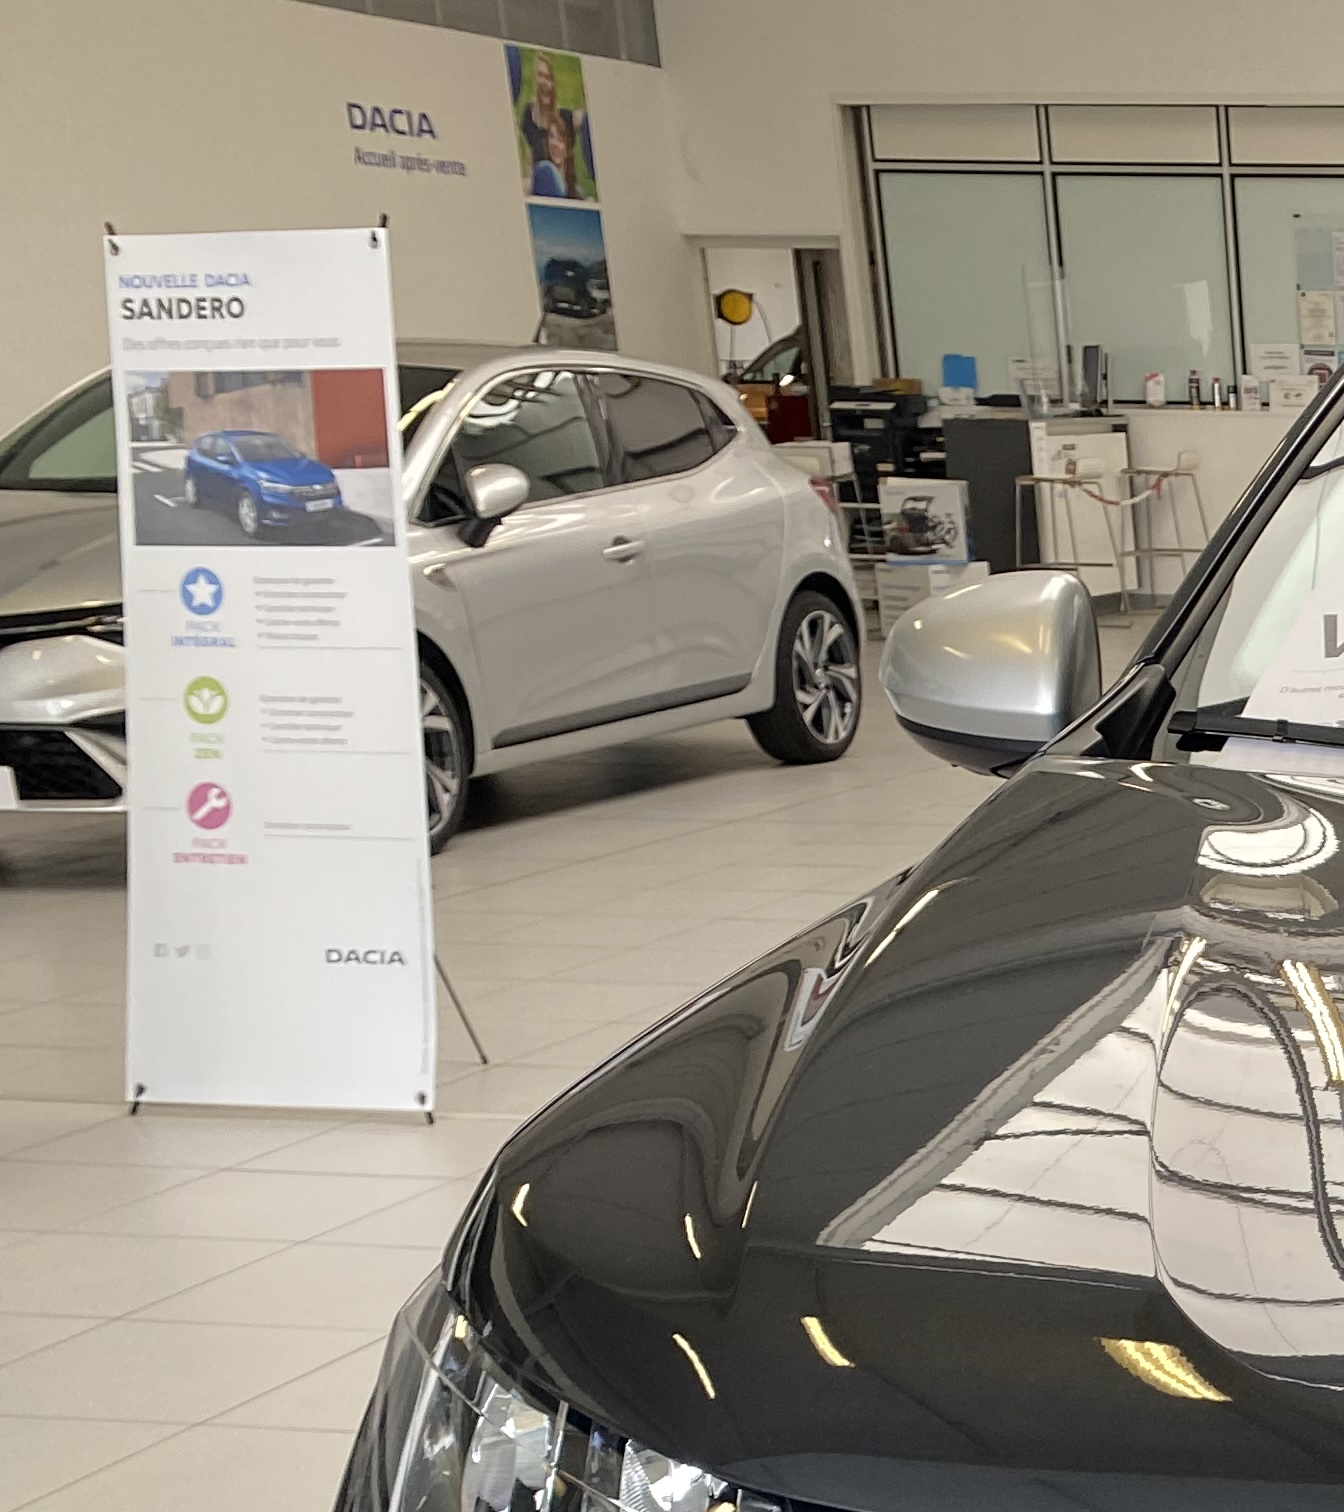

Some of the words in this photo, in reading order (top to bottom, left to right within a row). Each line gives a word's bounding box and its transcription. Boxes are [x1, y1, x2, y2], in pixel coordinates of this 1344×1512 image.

[346, 102, 438, 139] DACIA
[118, 274, 199, 289] NOUVELLE
[204, 273, 252, 288] DACIA
[120, 296, 246, 320] SANDERO
[324, 949, 408, 965] DACIA
